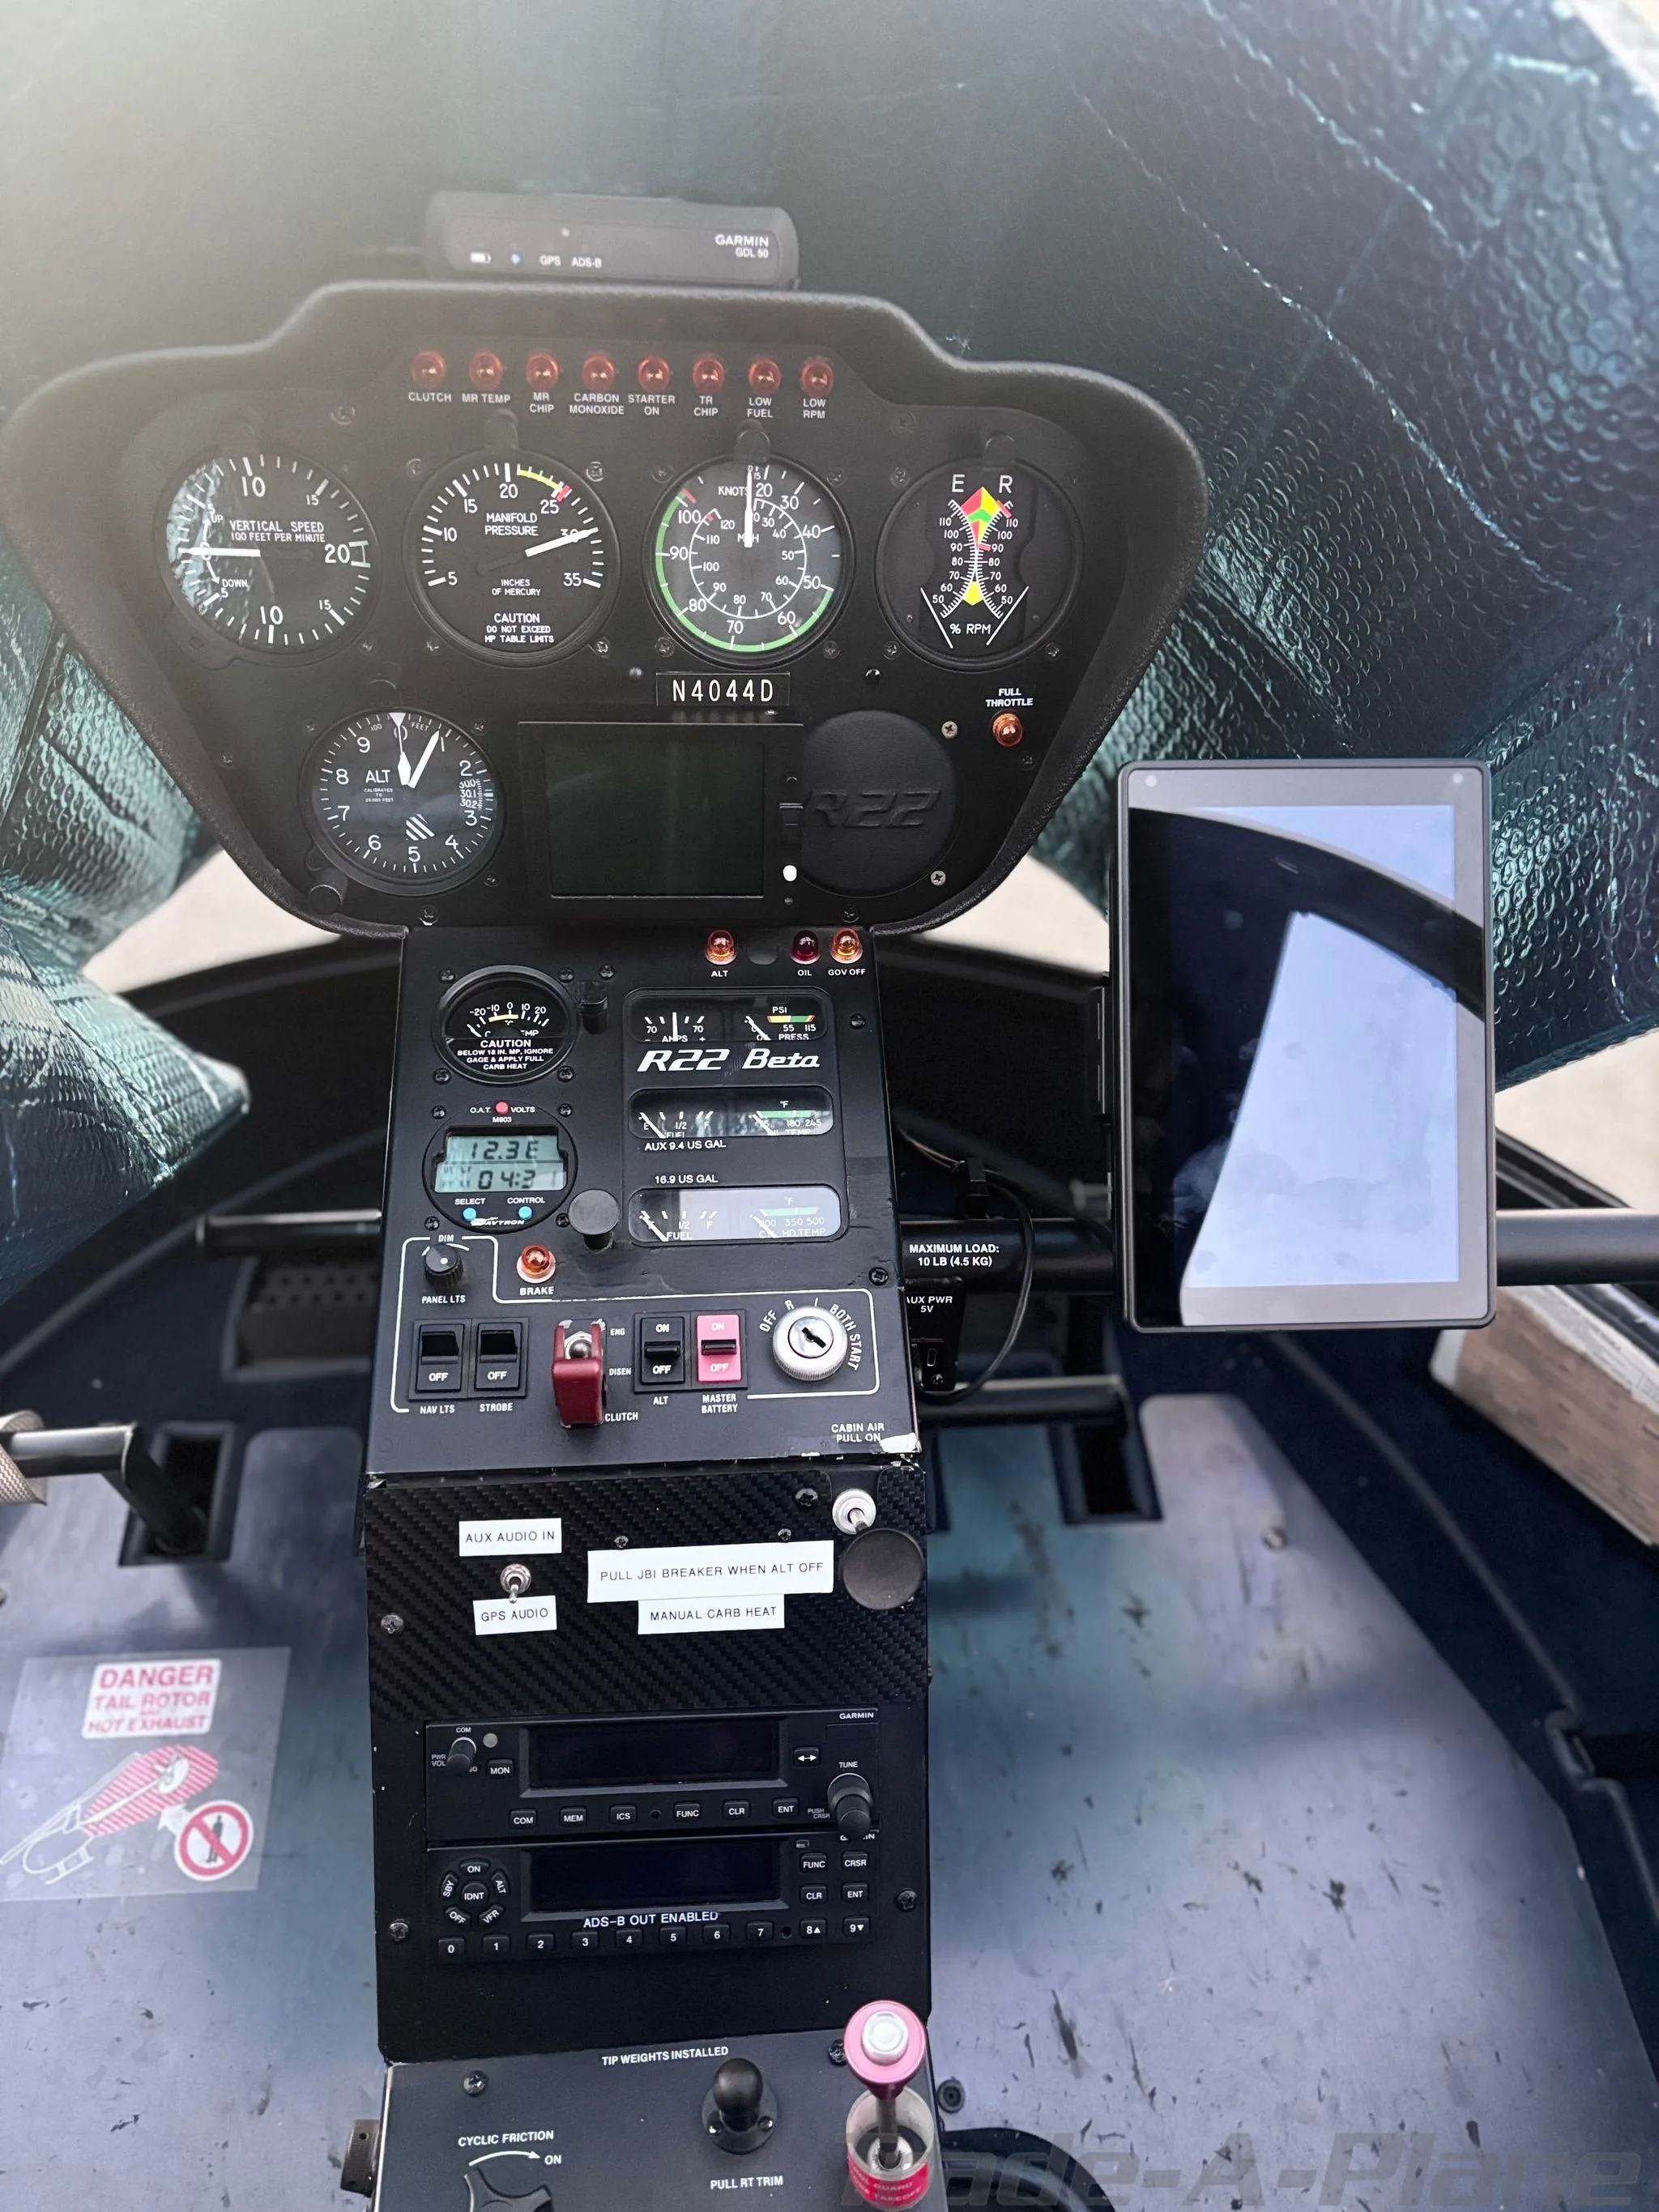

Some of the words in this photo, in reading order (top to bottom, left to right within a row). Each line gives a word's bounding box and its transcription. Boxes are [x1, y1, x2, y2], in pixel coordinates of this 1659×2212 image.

[715, 234, 769, 246] GARMIN
[736, 248, 756, 258] GDL
[757, 248, 769, 258] 50
[539, 256, 561, 266] GPS
[571, 258, 602, 268] ADS-B
[408, 392, 452, 403] CLUTCH
[462, 393, 480, 404] MR
[482, 394, 511, 404] TEMP
[533, 392, 550, 403] MR
[574, 393, 620, 404] CARBON
[628, 394, 676, 405] STARTER
[699, 395, 714, 406] TR
[748, 397, 772, 407] LOW
[803, 398, 826, 408] LOW
[530, 403, 555, 414] CHIP
[569, 404, 625, 416] MONOXIDE
[644, 405, 660, 416] ON
[694, 407, 719, 418] CHIP
[747, 408, 773, 419] FUEL
[803, 409, 825, 420] RPM
[540, 499, 560, 514] 25
[486, 513, 538, 523] MANIFOLD
[678, 509, 702, 524] 100
[229, 520, 282, 532] VERTICAL
[291, 521, 324, 533] SPEED
[484, 526, 539, 536] PRESSURE
[231, 532, 247, 541] 100
[249, 532, 271, 542] FEET
[274, 533, 292, 542] PER
[295, 533, 326, 543] MINUTE
[324, 544, 350, 564] 20
[222, 579, 248, 588] DOWN
[501, 579, 531, 587] INCHES
[492, 588, 502, 596] OF
[505, 588, 541, 596] MERCURY
[494, 612, 540, 623] CAUTION
[486, 625, 497, 633] DO
[501, 625, 517, 633] NOT
[521, 625, 551, 633] EXCEED
[966, 624, 992, 634] RPM
[484, 635, 498, 643] MP
[500, 635, 527, 643] TABLE
[530, 635, 554, 643] LIMITS
[672, 679, 774, 702] N4044D
[998, 688, 1022, 697] FULL
[985, 697, 1034, 707] THROTTLE
[365, 769, 390, 783] ALT
[805, 789, 941, 829] R22
[480, 1039, 531, 1048] CAUTION
[637, 1048, 730, 1072] R22
[742, 1047, 821, 1069] Beta
[644, 1142, 667, 1151] AUX
[669, 1141, 684, 1150] 9.4
[687, 1140, 702, 1149] US
[705, 1139, 726, 1149] GAL
[655, 1175, 676, 1184] 16.9
[678, 1174, 693, 1183] US
[696, 1174, 719, 1183] GAL
[438, 1234, 454, 1242] DIM
[909, 1244, 962, 1253] MAXIMUM
[965, 1244, 1000, 1253] LOAD:
[918, 1258, 930, 1266] 10
[932, 1257, 947, 1266] LB
[949, 1255, 969, 1268] (4.5
[972, 1255, 992, 1267] KG)
[519, 1286, 554, 1295] BRAKE
[450, 1295, 466, 1303] LTS
[928, 1296, 953, 1304] PWR
[920, 1305, 933, 1313] 5V
[829, 1303, 857, 1332] BOTH
[610, 1328, 625, 1336] ENG
[655, 1323, 670, 1333] ON
[847, 1333, 863, 1370] START
[608, 1367, 631, 1376] DISEN
[652, 1365, 672, 1375] OFF
[429, 1372, 448, 1382] OFF
[702, 1393, 736, 1403] MASTER
[420, 1405, 438, 1414] NAV
[440, 1404, 455, 1413] LTS
[479, 1403, 513, 1412] STROBE
[701, 1404, 738, 1413] BATTERY
[605, 1412, 638, 1421] CLUTCH
[831, 1423, 864, 1433] CABIN
[867, 1422, 885, 1432] AIR
[836, 1433, 861, 1443] PULL
[864, 1432, 881, 1442] ON
[465, 1532, 493, 1544] AUX
[497, 1531, 538, 1542] AUDIO
[542, 1530, 555, 1541] IN
[600, 1571, 632, 1581] PULL
[662, 1566, 722, 1579] BREAKER
[727, 1563, 767, 1576] WHEN
[770, 1562, 794, 1575] ALT
[798, 1562, 824, 1573] OFF
[480, 1609, 507, 1622] GPS
[510, 1607, 549, 1620] AUDIO
[650, 1609, 702, 1622] MANUAL
[706, 1607, 740, 1619] CARB
[745, 1606, 776, 1617] HEAT
[100, 1664, 213, 1689] DANGER
[94, 1694, 135, 1711] TAIL
[141, 1690, 211, 1708] ROTOR
[127, 1715, 209, 1732] EXHAUST
[564, 1814, 583, 1822] MEM
[803, 1860, 825, 1869] FUNC
[844, 1859, 867, 1867] CRSR
[495, 1879, 506, 1894] ALT
[464, 1892, 484, 1900] IDNT
[847, 1890, 864, 1899] ENT
[583, 1916, 625, 1928] ADS-B
[629, 1914, 656, 1925] OUT
[661, 1911, 719, 1923] ENABLED
[602, 2055, 618, 2065] TIP
[620, 2051, 669, 2065] WEIGHTS
[671, 2046, 729, 2061] INSTALLED
[458, 2133, 499, 2147] CYCLIC
[501, 2130, 554, 2145] FRICTION
[710, 2178, 738, 2189] PULL
[740, 2177, 754, 2189] RT
[757, 2175, 783, 2188] TRIM
